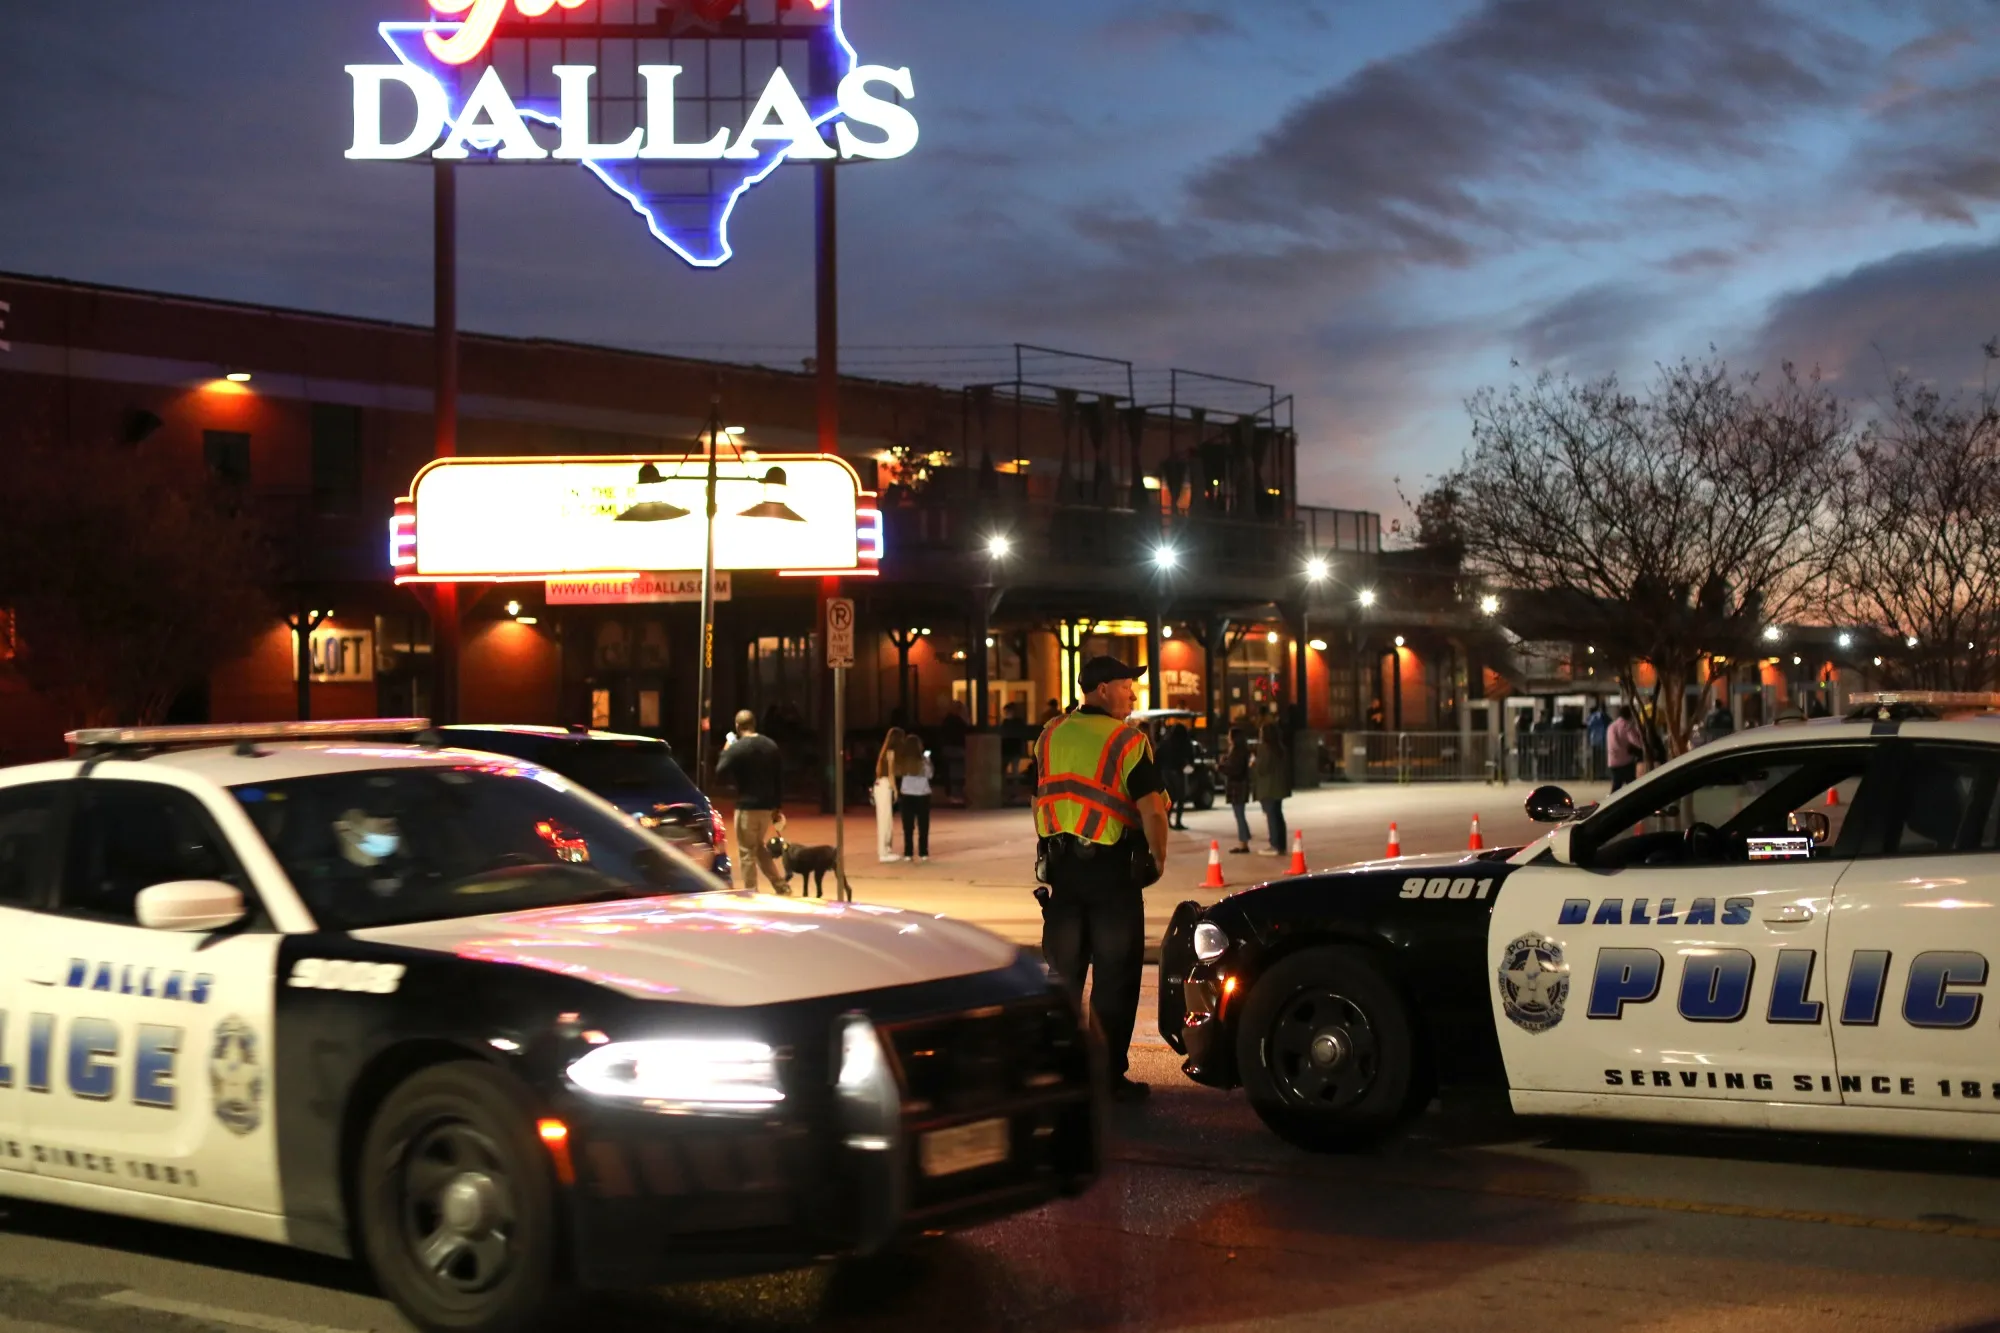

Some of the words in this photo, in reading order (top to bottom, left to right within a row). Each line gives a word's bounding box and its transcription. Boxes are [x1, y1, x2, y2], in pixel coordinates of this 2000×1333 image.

[344, 64, 919, 160] DALLAS
[831, 633, 849, 642] ANY
[831, 644, 849, 656] TIME
[1399, 878, 1494, 900] 9001
[1558, 897, 1755, 925] DALLAS
[1507, 939, 1560, 957] POLICE
[66, 957, 214, 1005] DALLAS
[1586, 947, 2000, 1030] POLIC
[1604, 1069, 1773, 1091] SERVING
[1793, 1075, 1915, 1096] SINCE
[31, 1144, 116, 1175] SINCE
[125, 1160, 199, 1188] 1881
